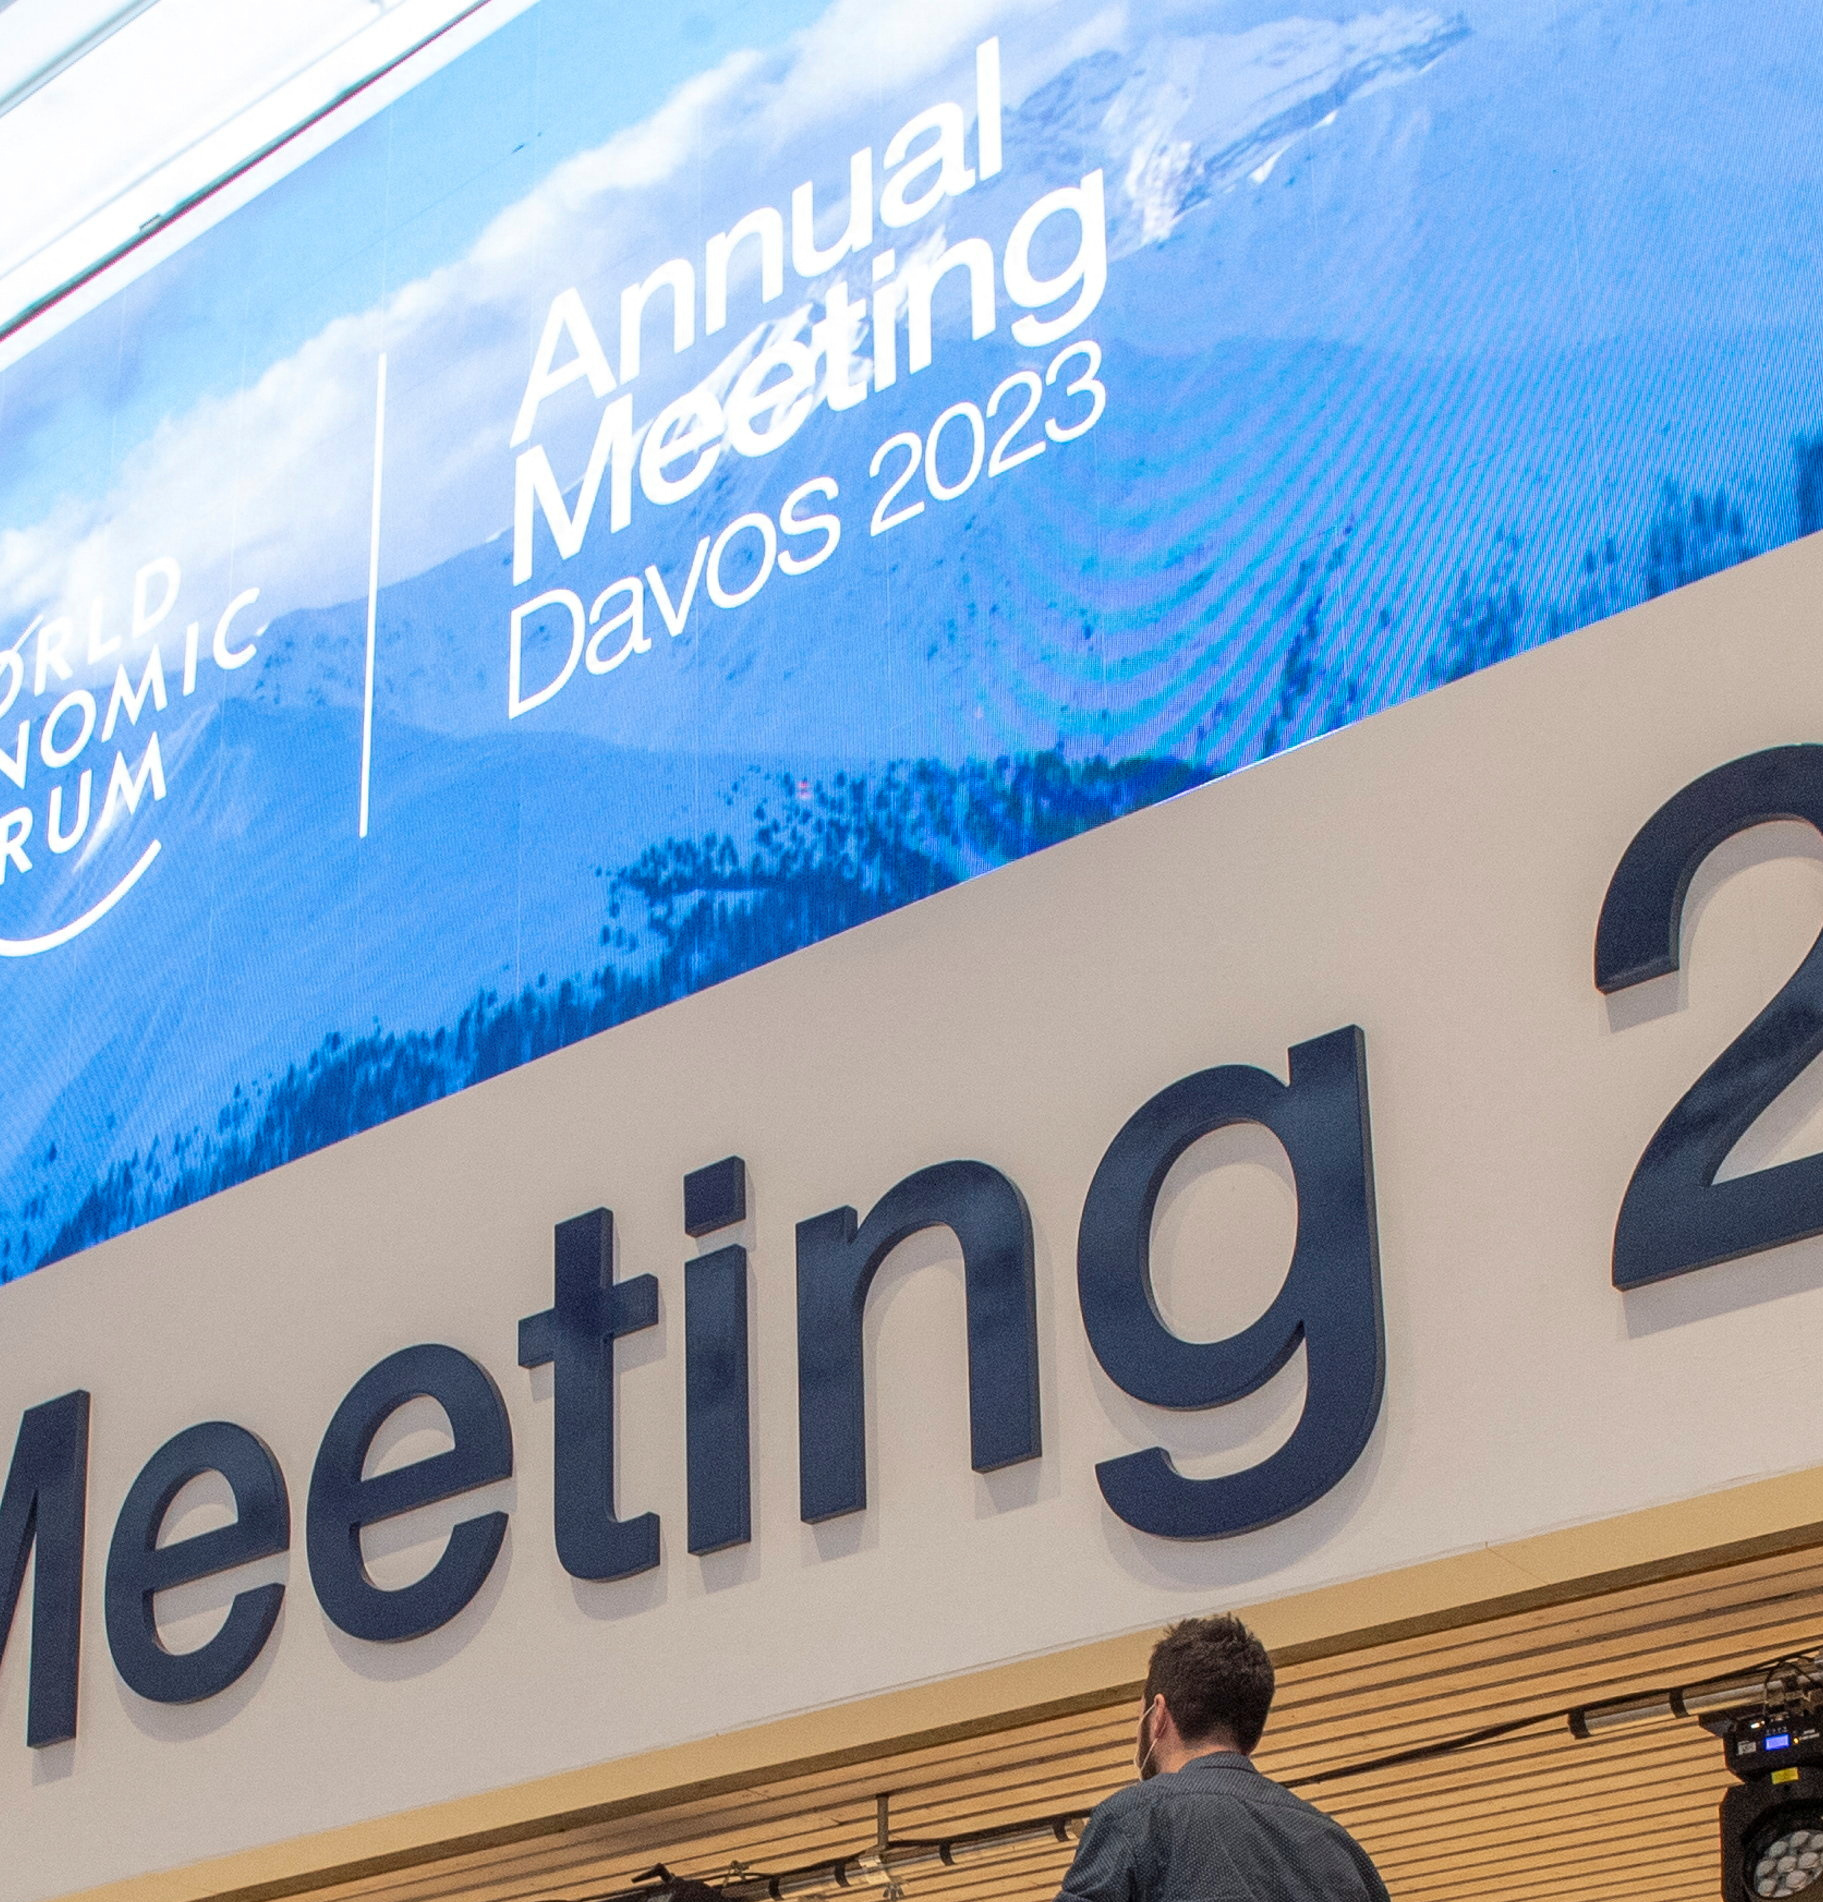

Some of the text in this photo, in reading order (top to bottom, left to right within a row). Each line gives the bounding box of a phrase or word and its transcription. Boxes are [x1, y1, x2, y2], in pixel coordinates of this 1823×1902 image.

[510, 36, 1003, 449] Annual
[512, 168, 1108, 587] Meeting
[508, 339, 1107, 719] Davos 2023
